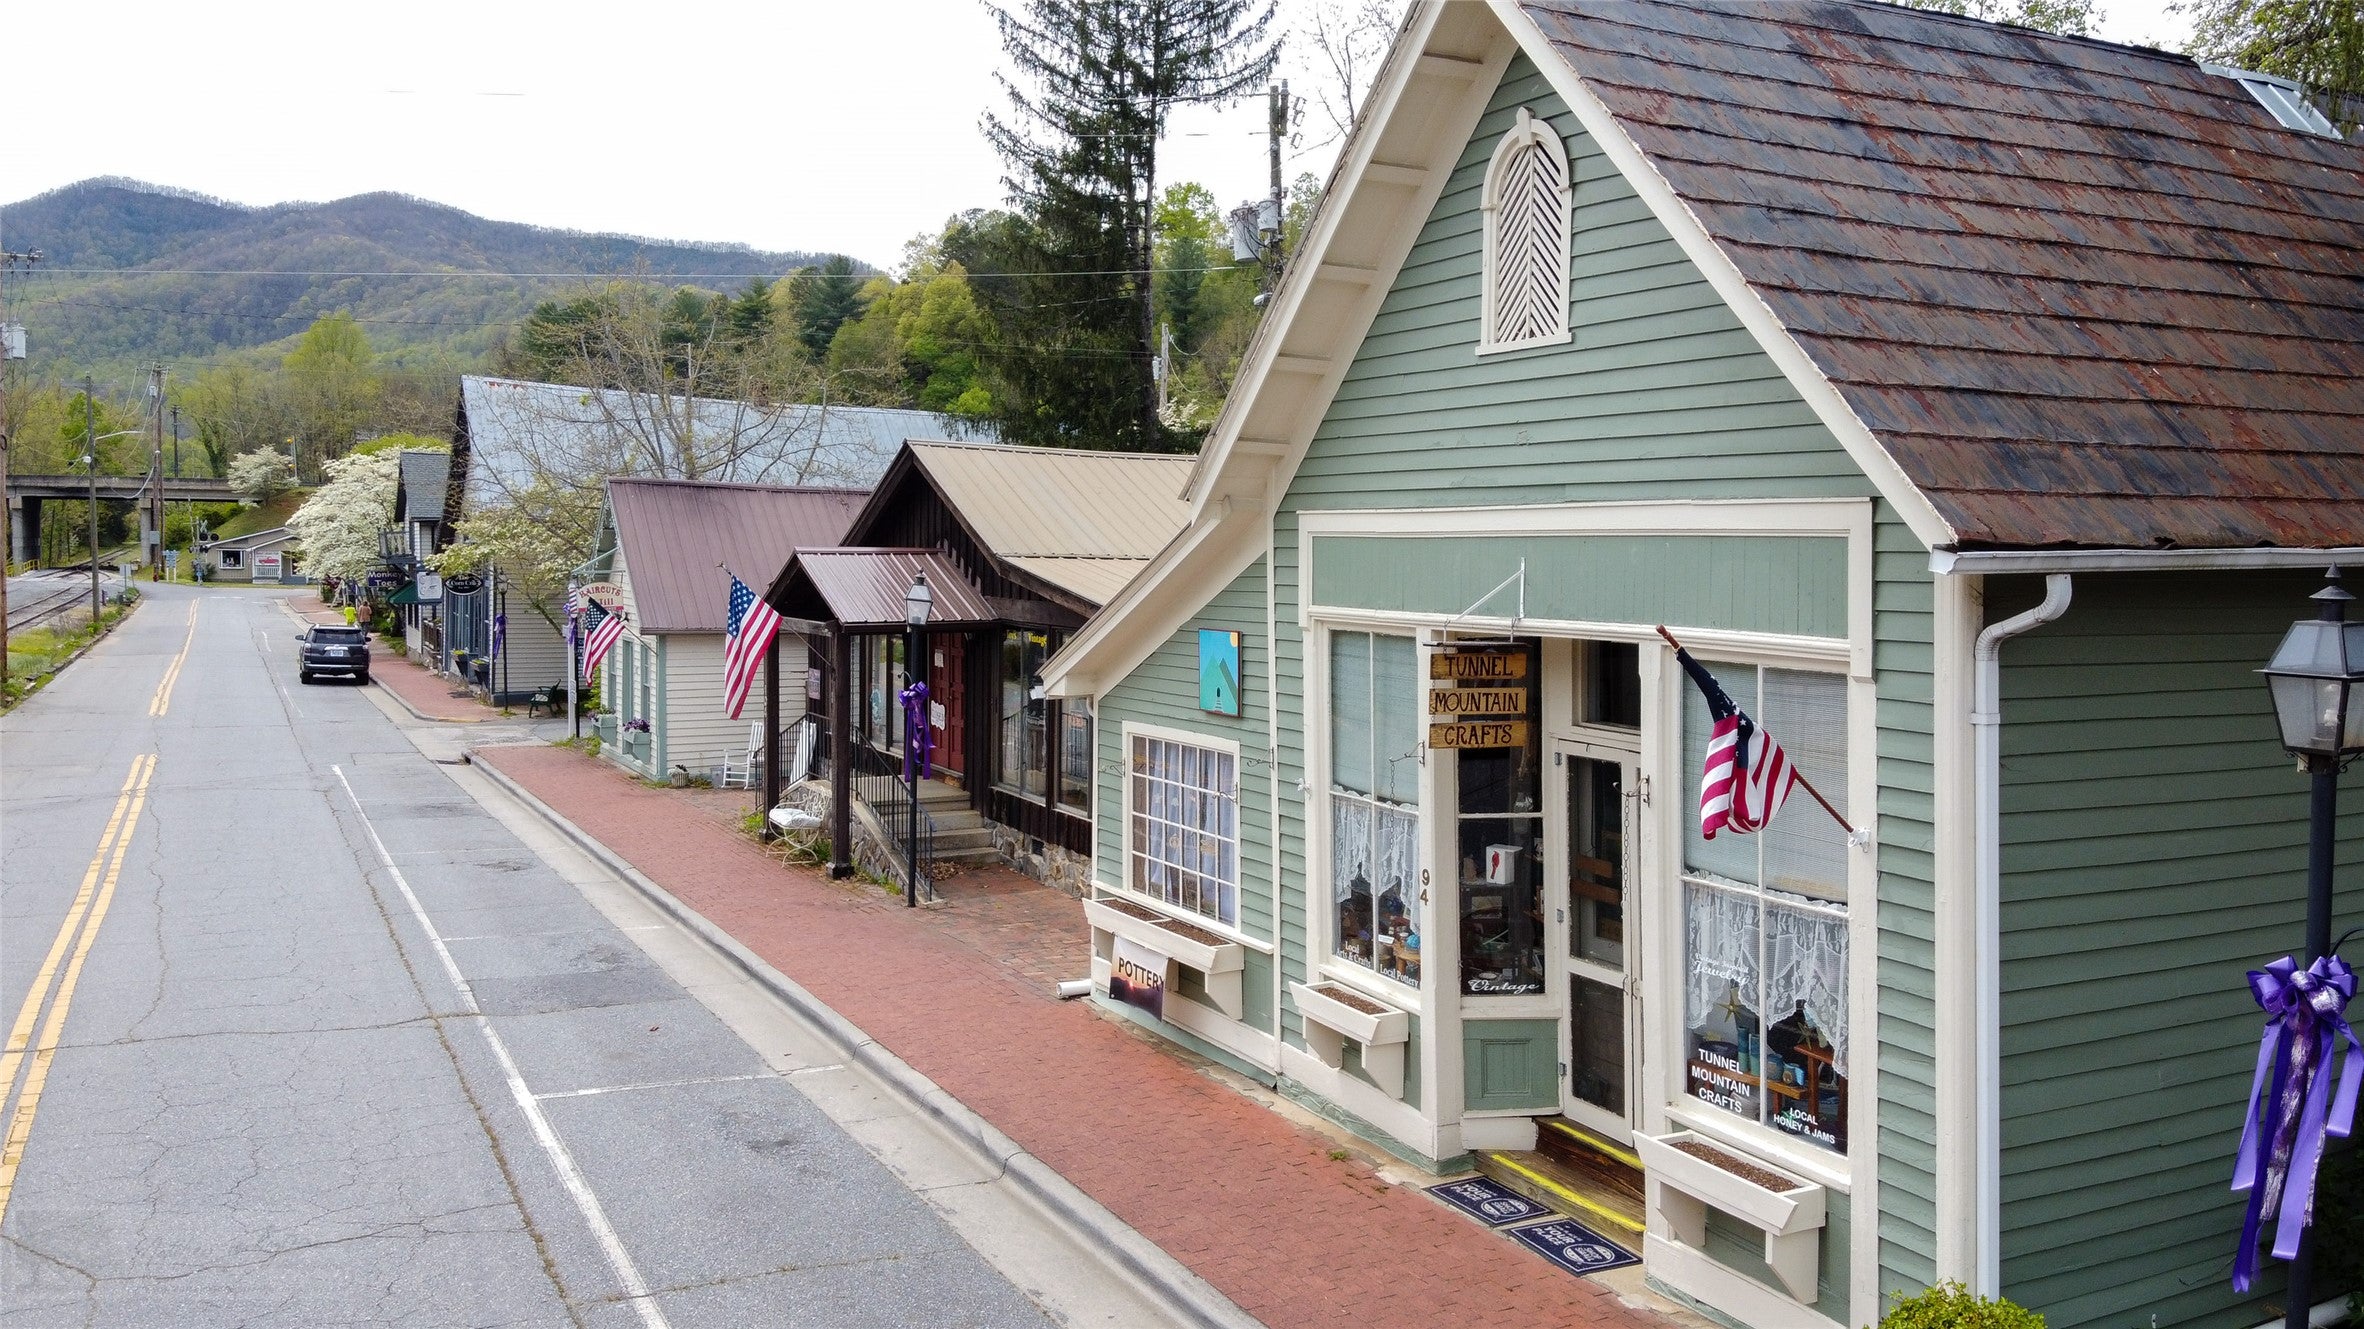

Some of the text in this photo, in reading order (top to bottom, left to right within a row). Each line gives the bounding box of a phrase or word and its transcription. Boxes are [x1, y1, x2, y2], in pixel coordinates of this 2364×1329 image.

[367, 571, 402, 579] Monkey
[375, 579, 398, 587] Toes
[578, 585, 622, 599] HAIRCUTS
[1444, 654, 1513, 678] TUNNEL
[1434, 691, 1519, 714] MOUNTAIN
[1444, 724, 1512, 745] CRAFTS
[1345, 940, 1360, 953] Local
[1336, 948, 1348, 960] Arts
[1353, 954, 1371, 967] Crafts
[1118, 957, 1164, 992] POTTERY
[1380, 963, 1419, 987] Local Pottery
[1693, 960, 1751, 986] Jewelry
[1468, 978, 1538, 995] Vintage
[1698, 1048, 1744, 1075] TUNNEL
[1691, 1066, 1750, 1097] MOUNTAIN
[1698, 1088, 1742, 1113] CRAFTS
[1789, 1107, 1819, 1126] LOCAL
[1773, 1113, 1836, 1144] HONEY & JAMS
[1450, 1185, 1482, 1202] PLACE
[1461, 1183, 1492, 1199] YOUR
[1532, 1227, 1566, 1246] PLACE
[1544, 1226, 1575, 1244] YOUR
